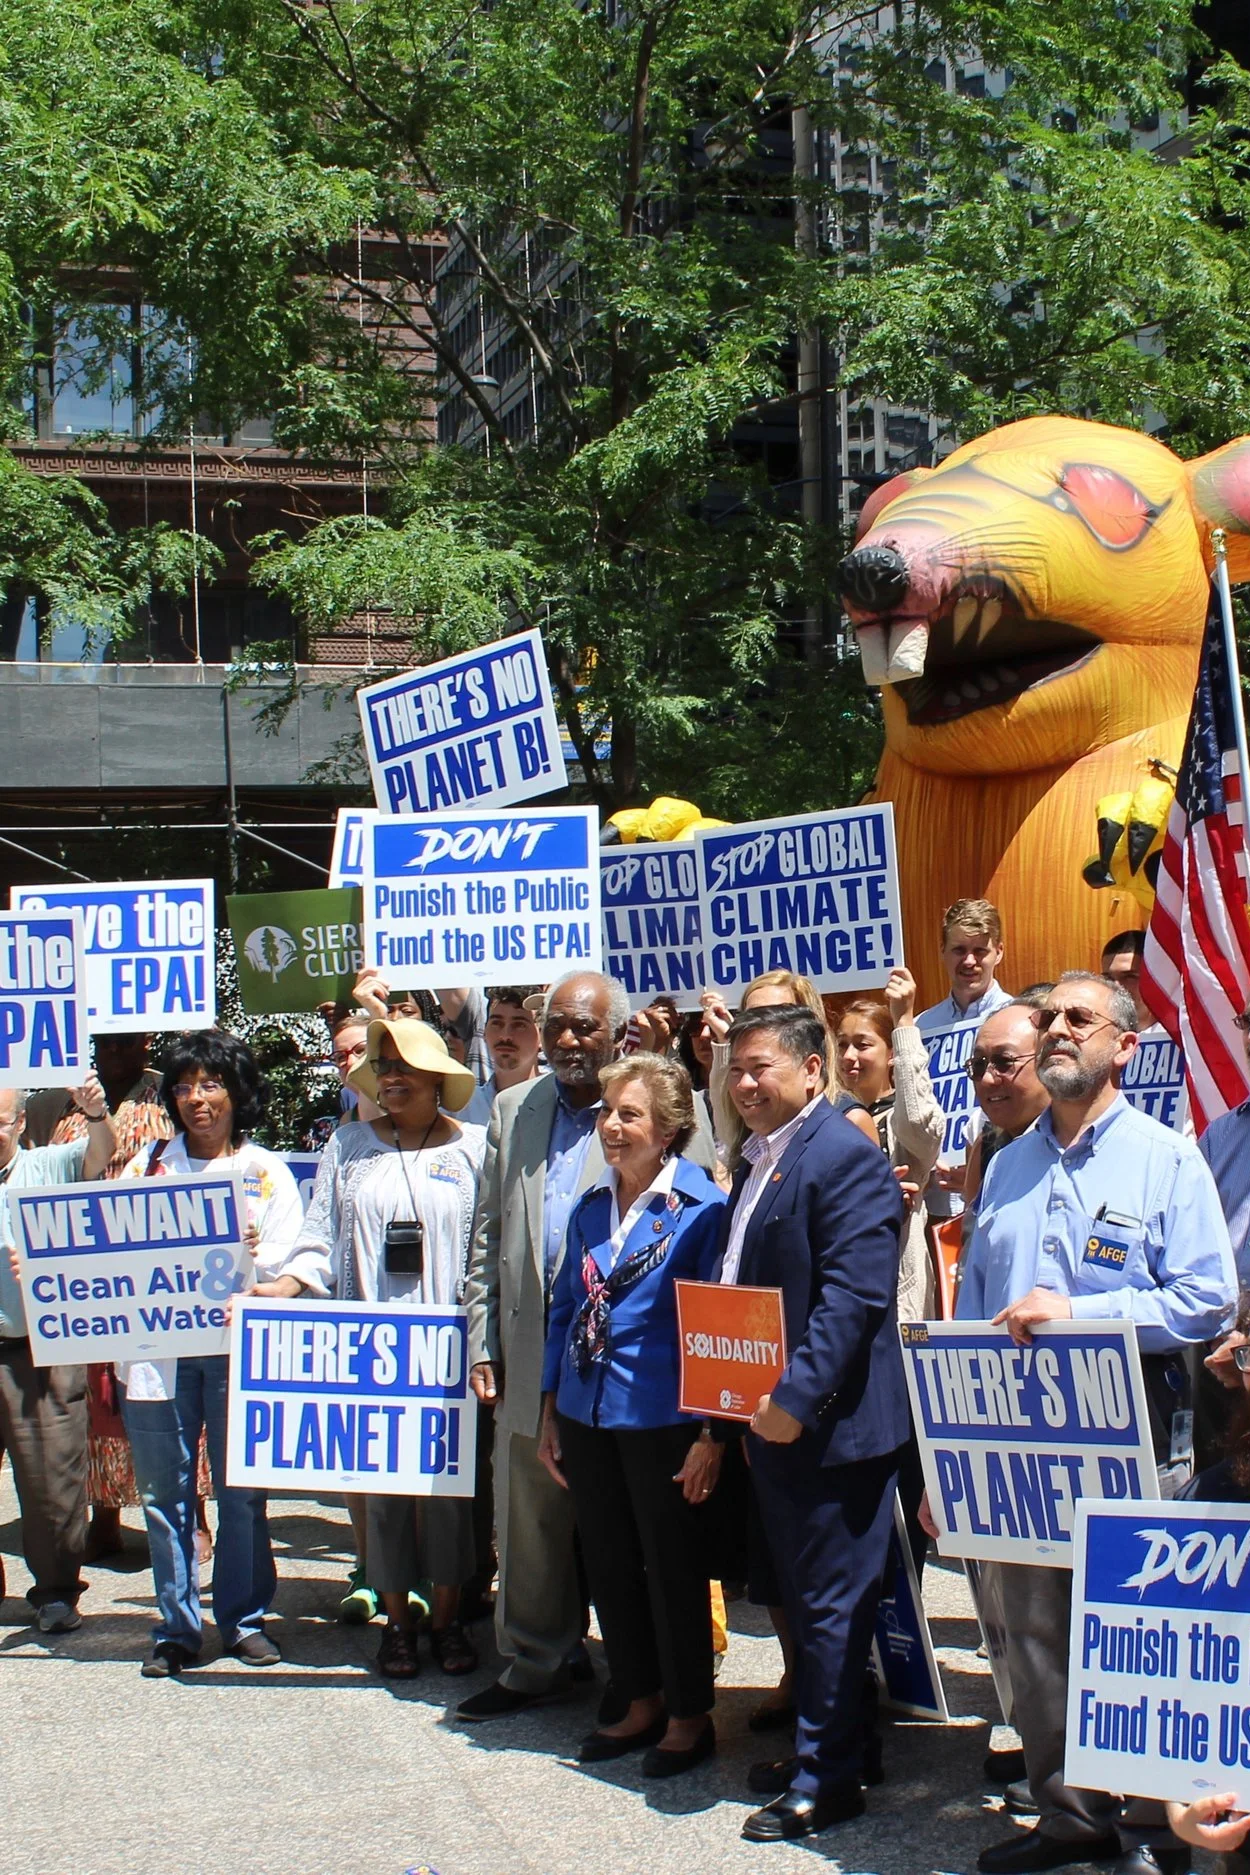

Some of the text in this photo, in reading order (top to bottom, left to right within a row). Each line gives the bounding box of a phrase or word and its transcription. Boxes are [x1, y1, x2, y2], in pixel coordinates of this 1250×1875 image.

[371, 651, 537, 752] THERE'S NO
[384, 717, 551, 814] PLANET B!
[402, 820, 558, 873] DON'T
[643, 853, 697, 899] GLO
[707, 818, 882, 892] STOP GLOBAL
[134, 893, 204, 947] the
[375, 876, 590, 919] Punish the Public
[711, 875, 889, 938] CLIMATE
[0, 925, 73, 990] the
[302, 924, 364, 951] SIER
[305, 950, 364, 977] CLUB
[376, 922, 591, 966] Fund the US EPA!
[711, 923, 895, 985] CHANGE!
[112, 956, 205, 1015] EPA!
[0, 1000, 78, 1068] PA!
[1125, 1042, 1181, 1085] OBAL
[22, 1198, 95, 1251] WE
[96, 1187, 232, 1244] WANT
[1098, 1245, 1127, 1263] AFGE
[32, 1272, 135, 1303] Clean
[38, 1303, 225, 1339] Clean Wate
[911, 1329, 929, 1342] AFGE
[247, 1318, 462, 1388] THERE'S NO
[916, 1347, 1131, 1430] THERE'S NO
[245, 1400, 460, 1476] PLANET B!
[936, 1449, 1084, 1542] PLANET
[1082, 1613, 1179, 1678] Punish
[1188, 1622, 1240, 1685] the
[1079, 1689, 1148, 1755] Fund
[1157, 1699, 1209, 1763] the
